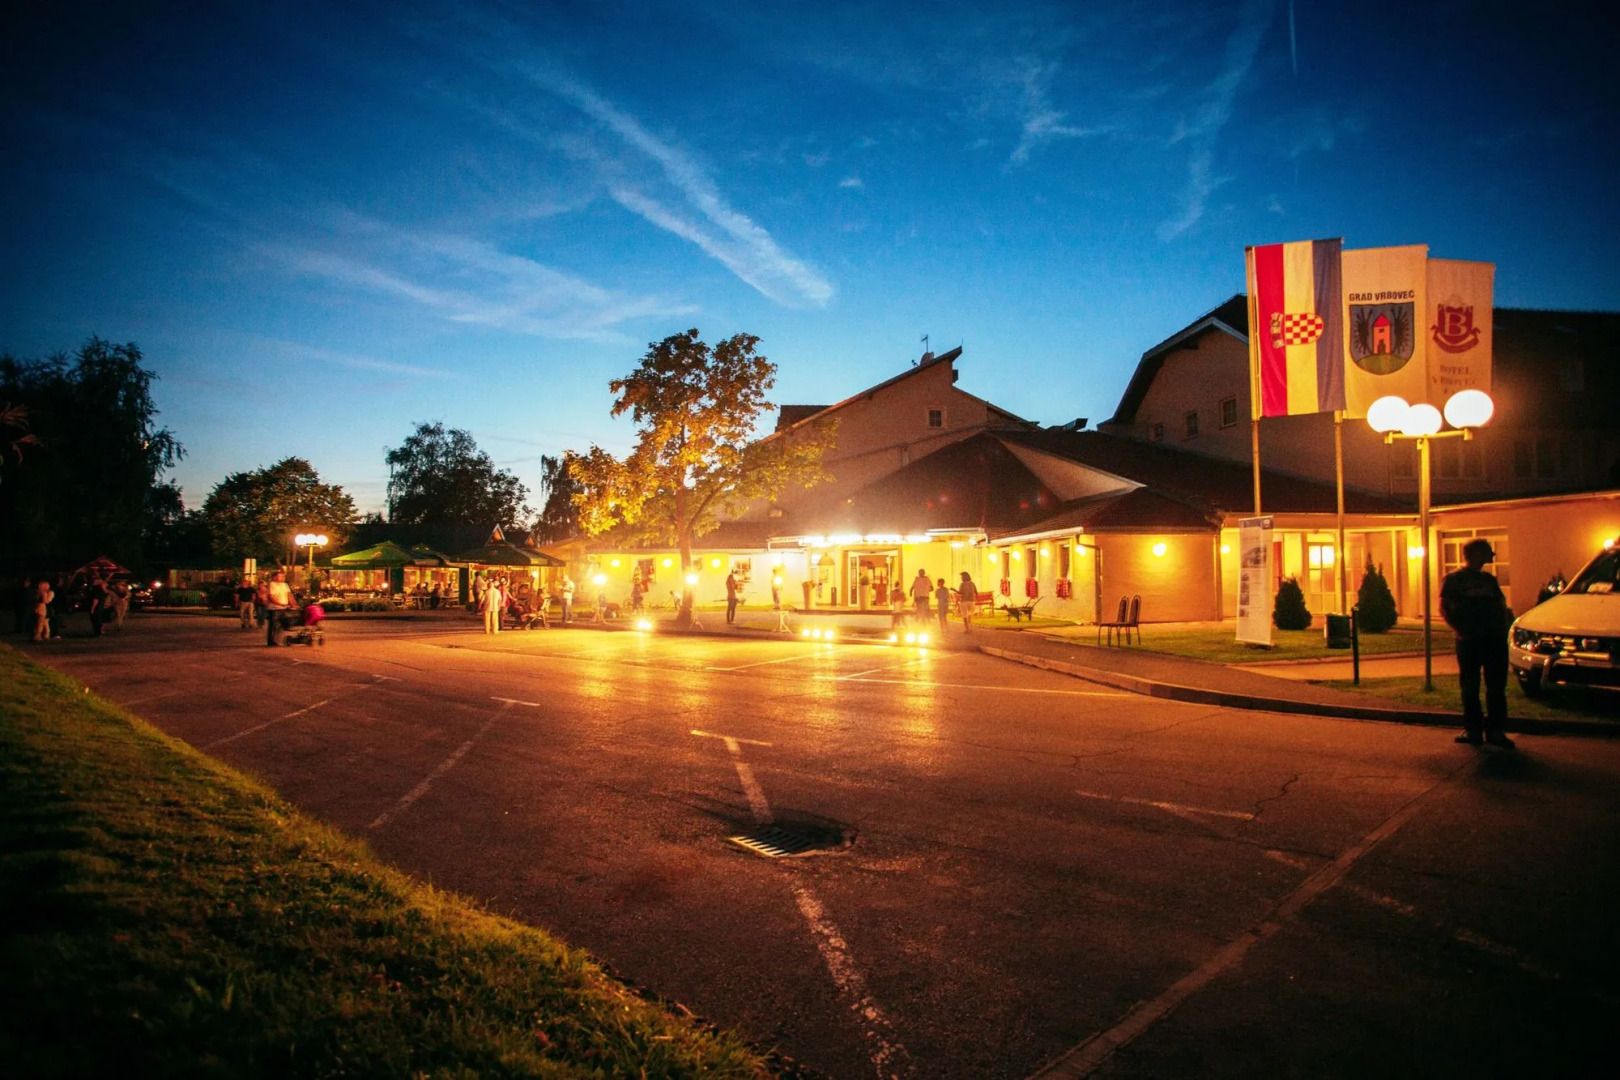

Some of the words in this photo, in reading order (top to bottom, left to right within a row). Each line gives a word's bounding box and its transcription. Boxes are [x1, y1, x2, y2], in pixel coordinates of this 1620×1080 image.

[1349, 292, 1373, 301] GRAD
[1374, 290, 1415, 301] VRBOVEC
[1444, 312, 1468, 336] B
